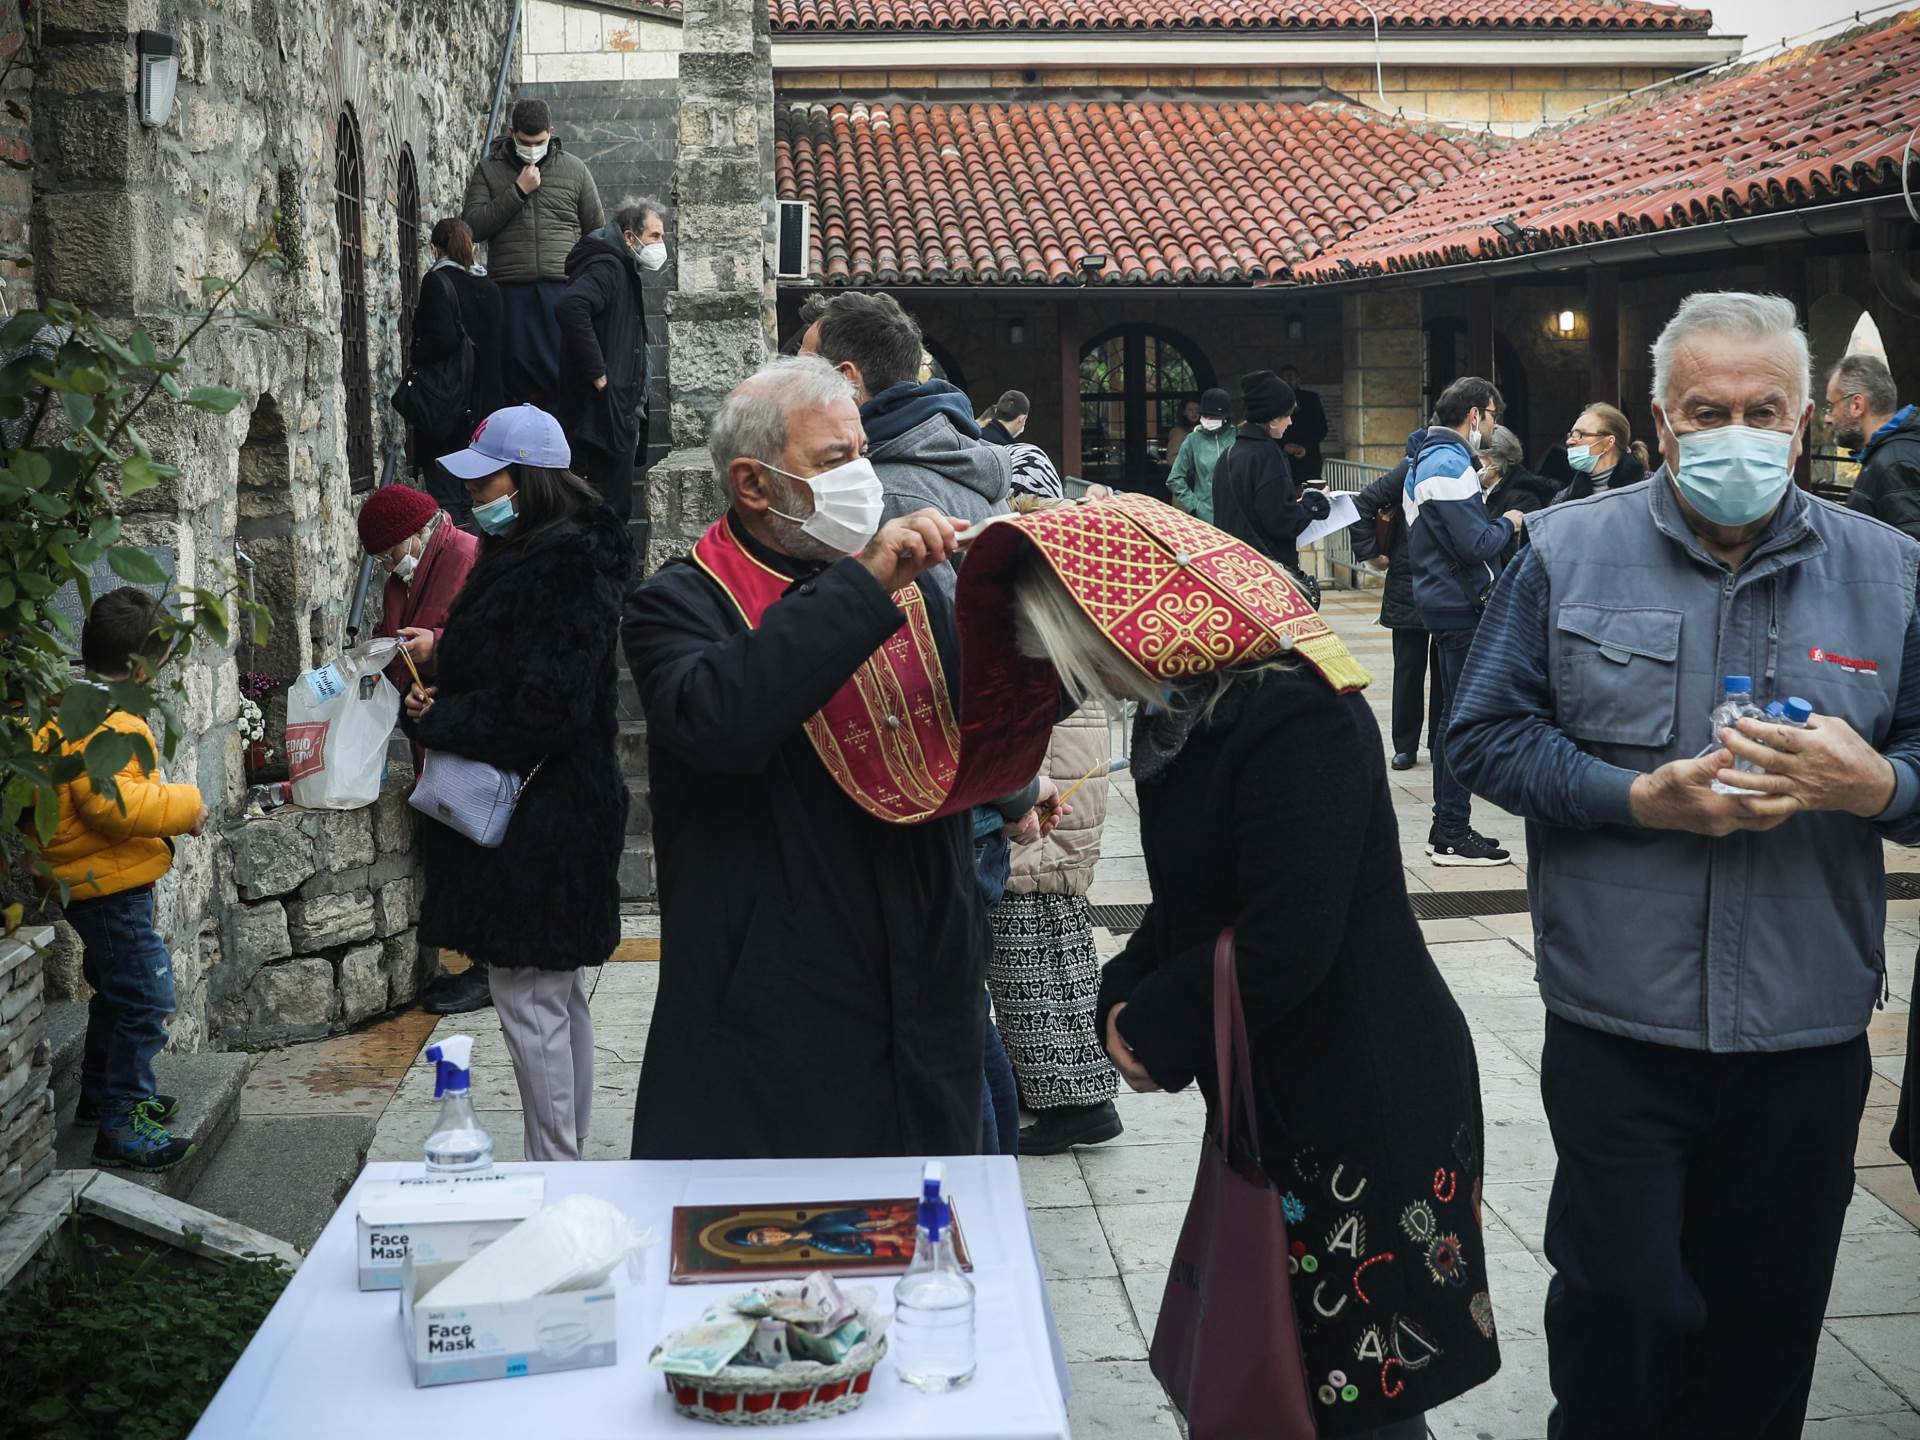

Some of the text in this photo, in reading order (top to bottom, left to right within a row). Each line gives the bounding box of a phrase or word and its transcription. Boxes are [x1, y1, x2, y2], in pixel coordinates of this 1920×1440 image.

[370, 1233, 409, 1246] Face
[428, 1324, 472, 1338] Face
[429, 1335, 476, 1353] Mask
